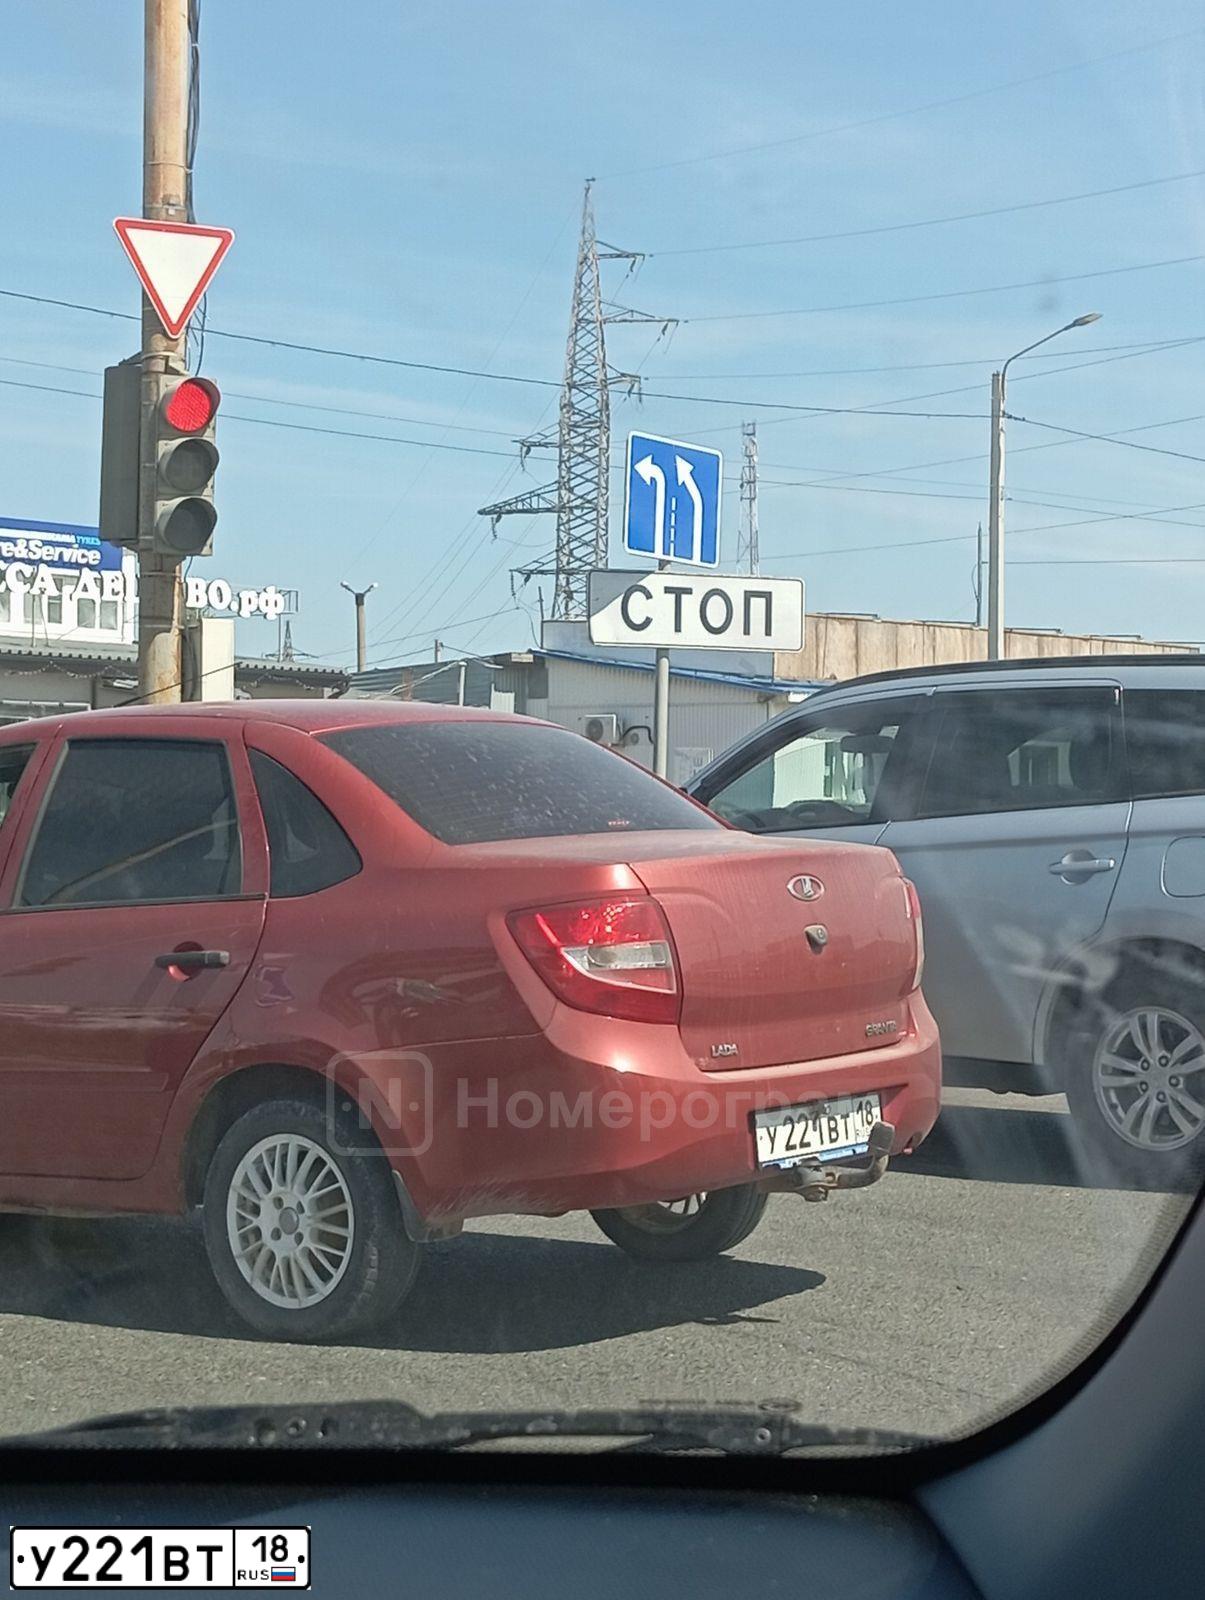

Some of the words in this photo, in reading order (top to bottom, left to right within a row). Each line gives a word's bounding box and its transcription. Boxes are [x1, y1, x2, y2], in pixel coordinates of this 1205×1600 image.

[0, 538, 101, 565] e&Service
[621, 584, 773, 636] СТОП
[711, 1043, 739, 1058] LADA
[857, 1100, 874, 1127] 18
